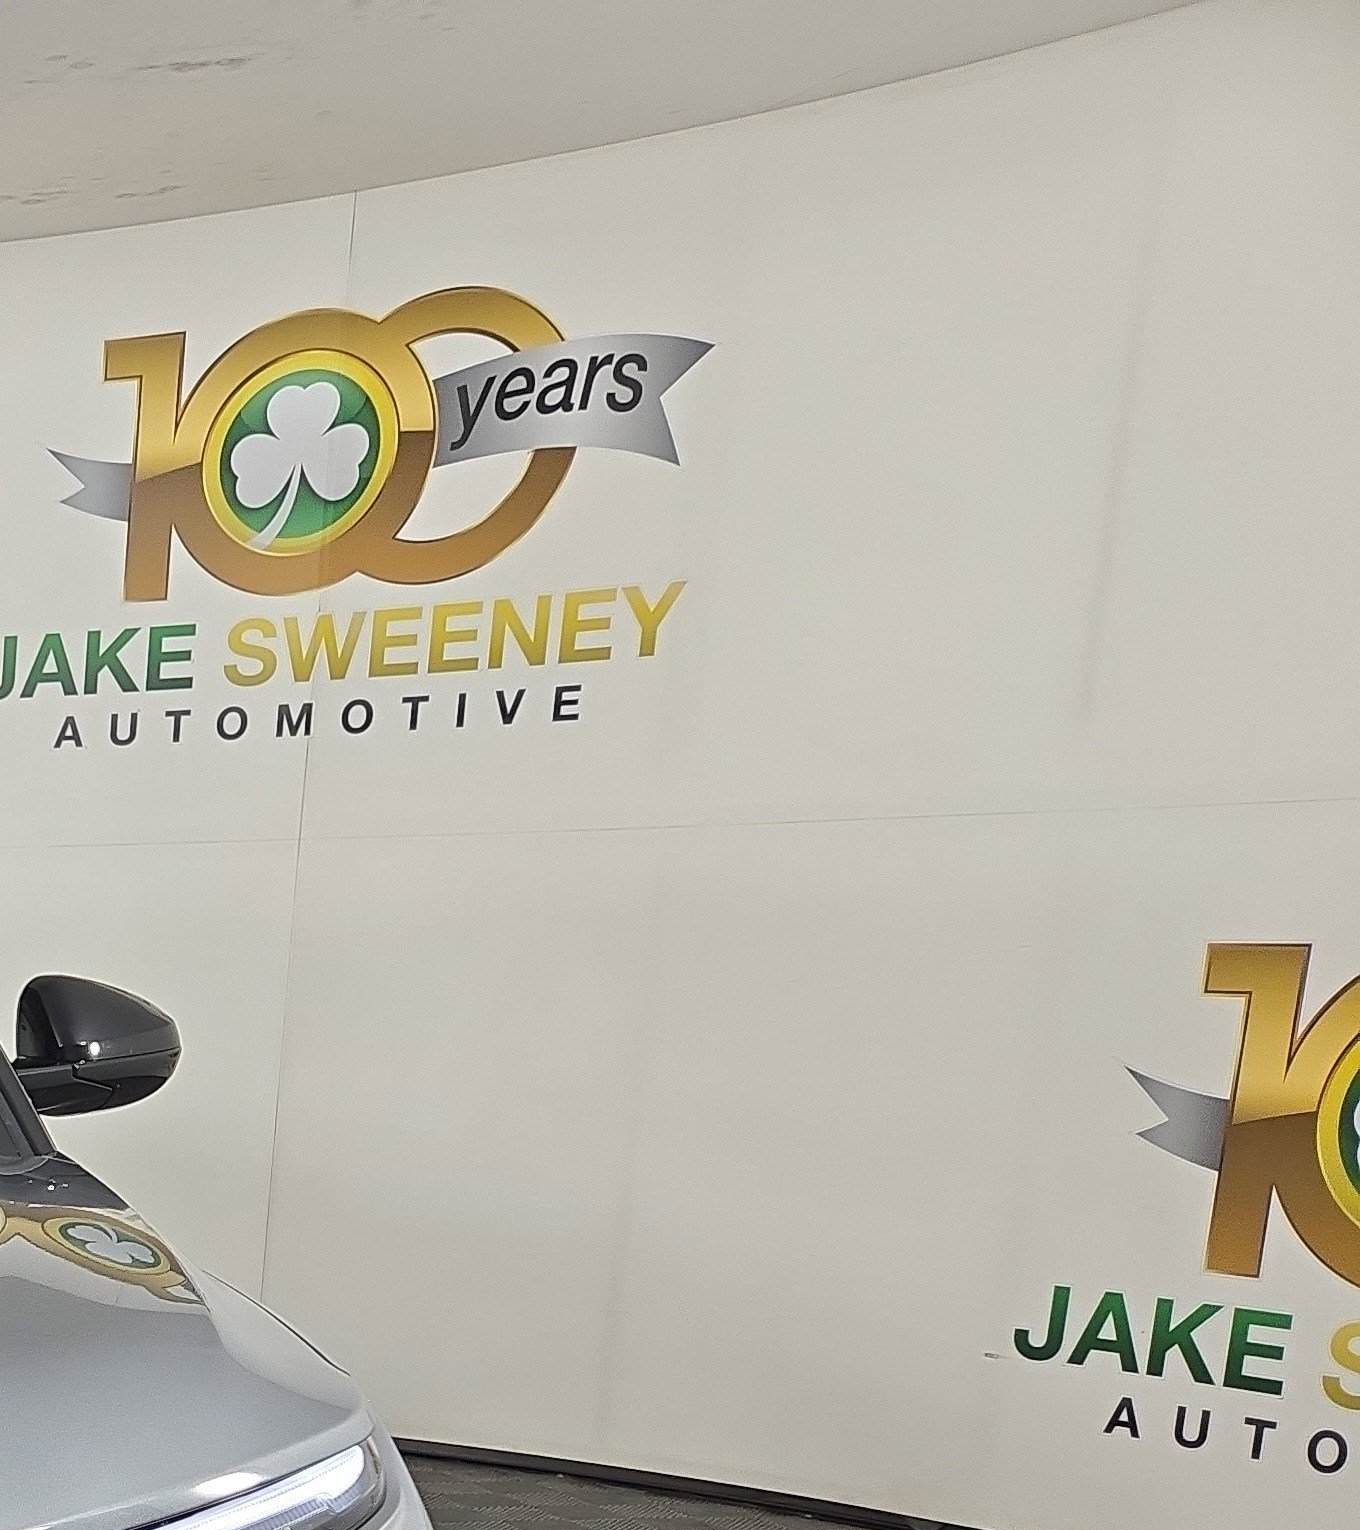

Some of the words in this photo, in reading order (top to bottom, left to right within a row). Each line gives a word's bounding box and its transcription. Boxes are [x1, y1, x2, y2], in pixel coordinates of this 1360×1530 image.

[103, 286, 578, 602] 100
[449, 353, 648, 451] years
[222, 581, 688, 688] SWEENEY
[53, 684, 582, 749] AUTOMOTIVE
[1013, 1285, 1294, 1397] JAKE
